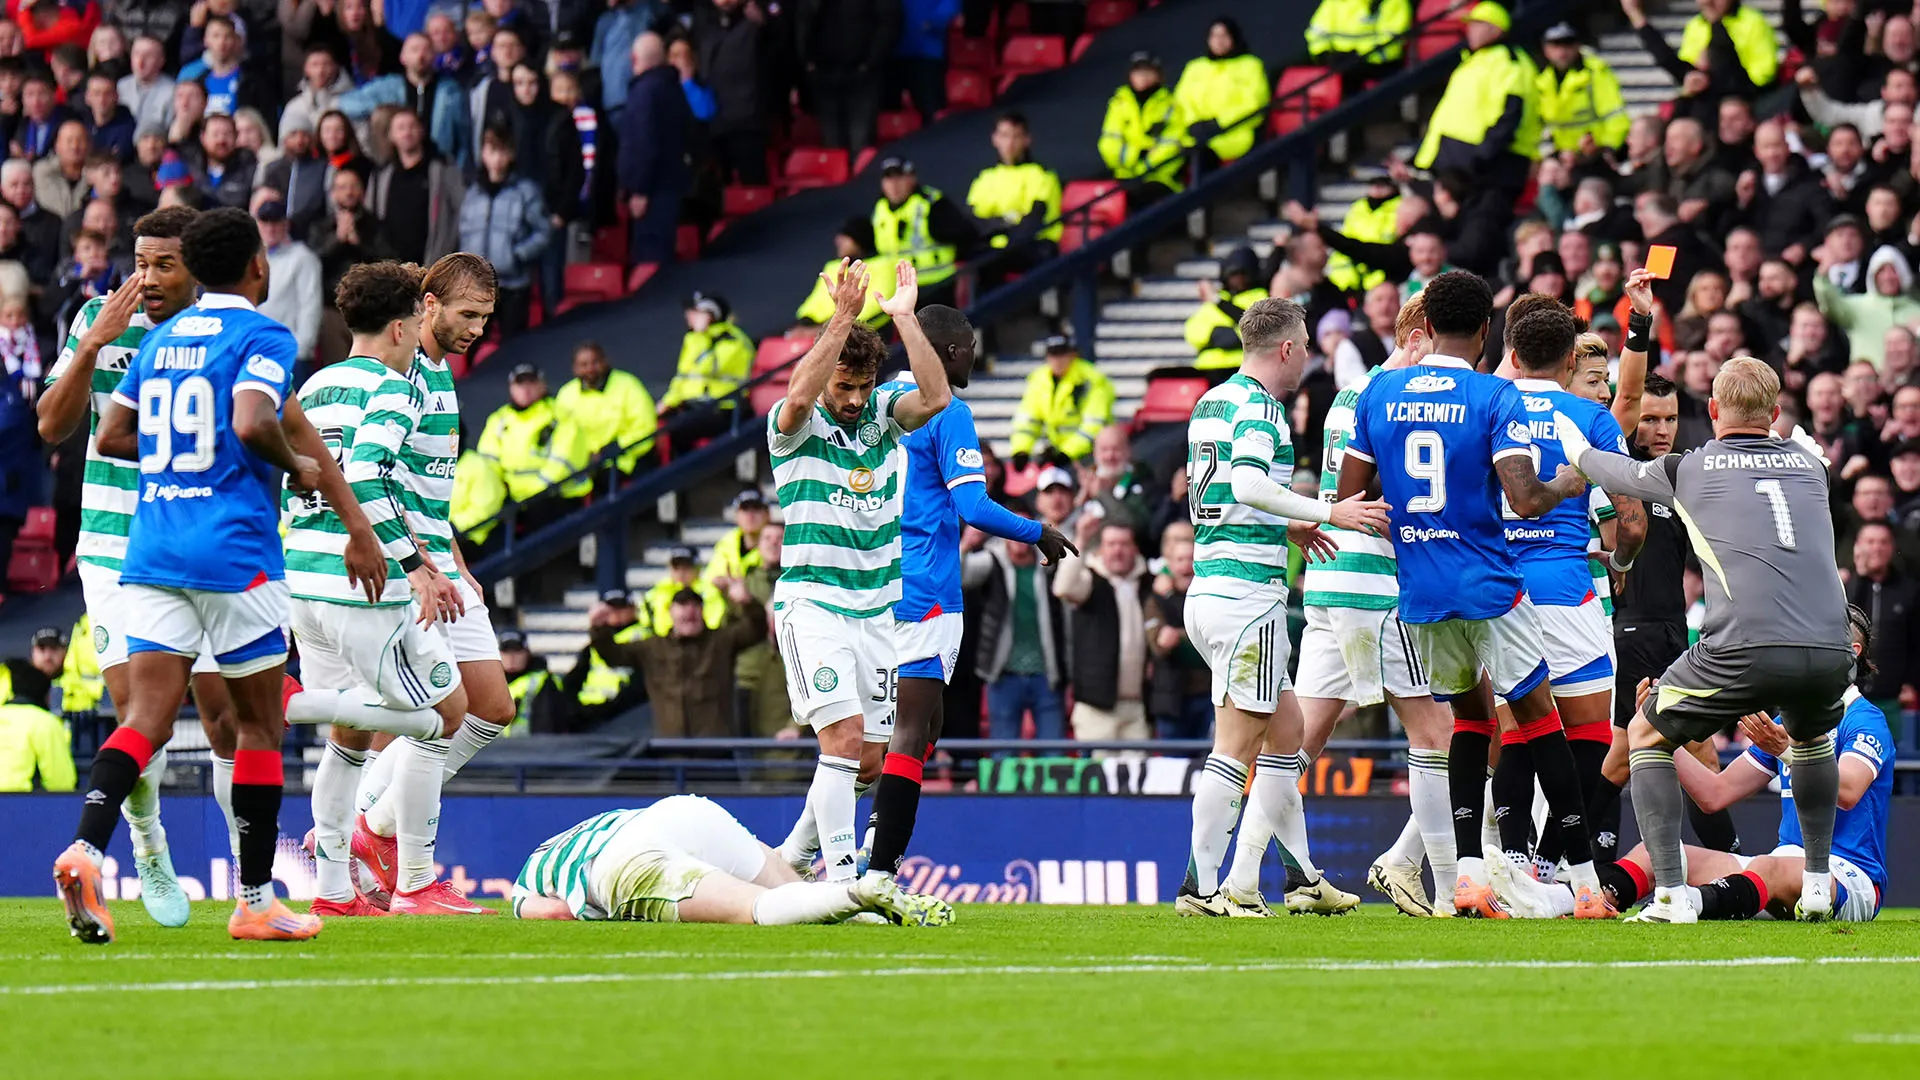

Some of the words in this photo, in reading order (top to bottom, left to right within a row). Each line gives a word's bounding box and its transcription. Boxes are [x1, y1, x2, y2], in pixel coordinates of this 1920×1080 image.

[154, 346, 207, 370] DANILO
[138, 375, 216, 475] 99
[1386, 402, 1466, 423] Y.CHERMITI
[1404, 430, 1447, 513] 9
[1703, 453, 1813, 470] SCHMEICHEL
[1755, 479, 1796, 548] 1
[830, 833, 854, 843] CELTIC
[1038, 860, 1159, 905] HILL
